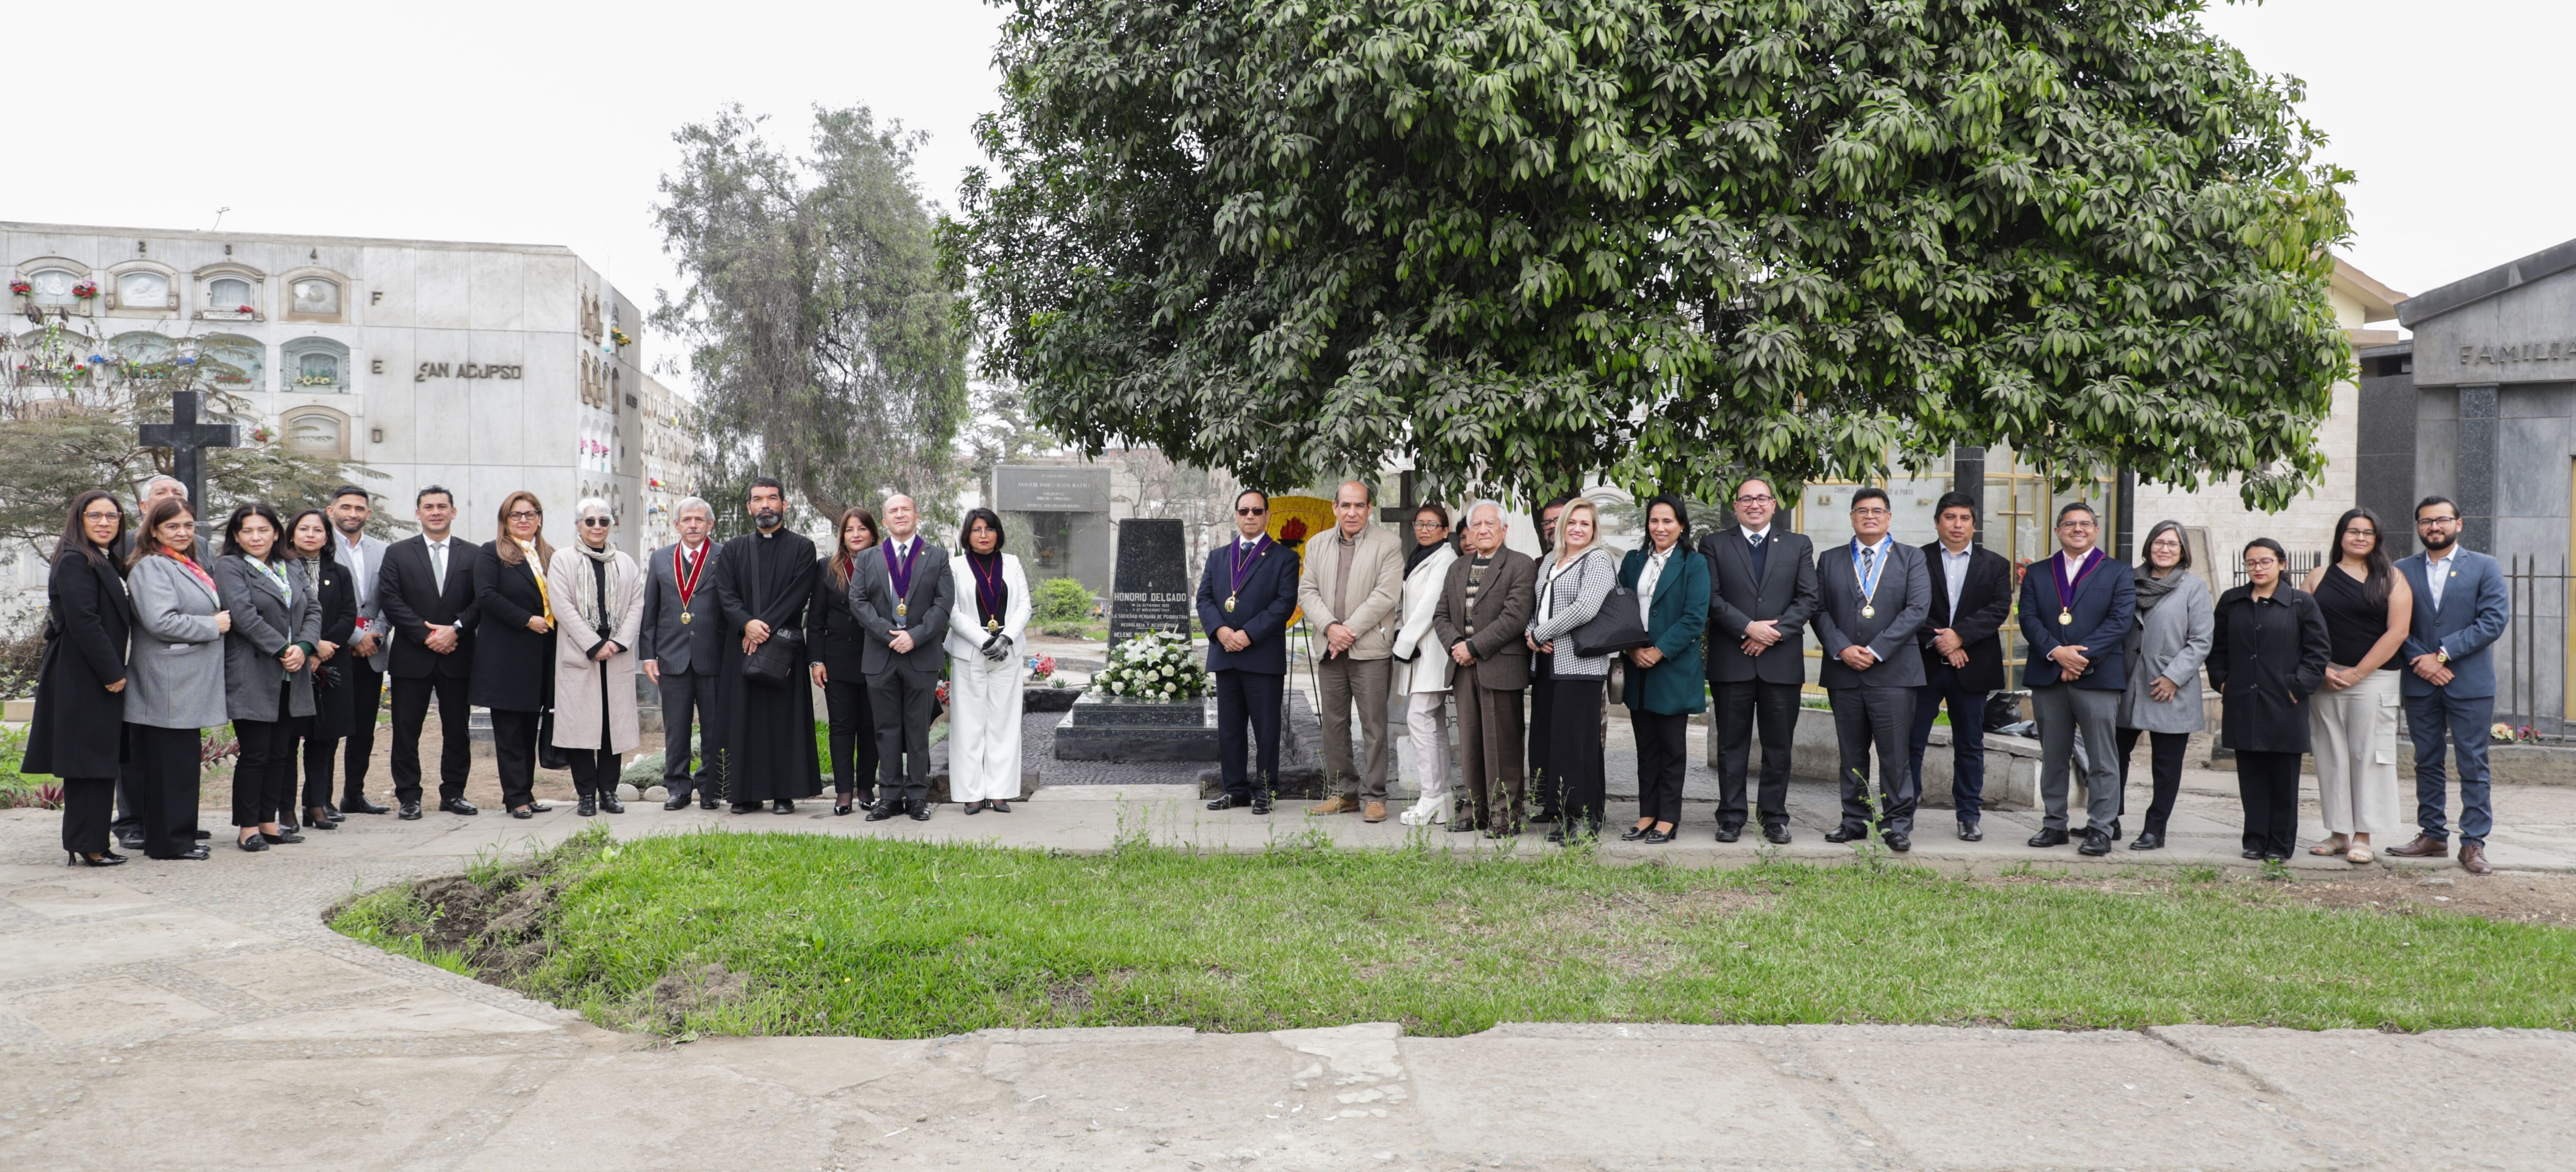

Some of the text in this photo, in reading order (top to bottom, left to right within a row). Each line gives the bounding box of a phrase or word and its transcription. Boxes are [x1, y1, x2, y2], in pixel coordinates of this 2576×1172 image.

[138, 241, 146, 252] 2
[225, 245, 232, 255] 3
[309, 248, 318, 259] 4
[371, 292, 383, 306] F
[371, 360, 383, 374] E
[1114, 593, 1187, 602] HONORIO DELGADO
